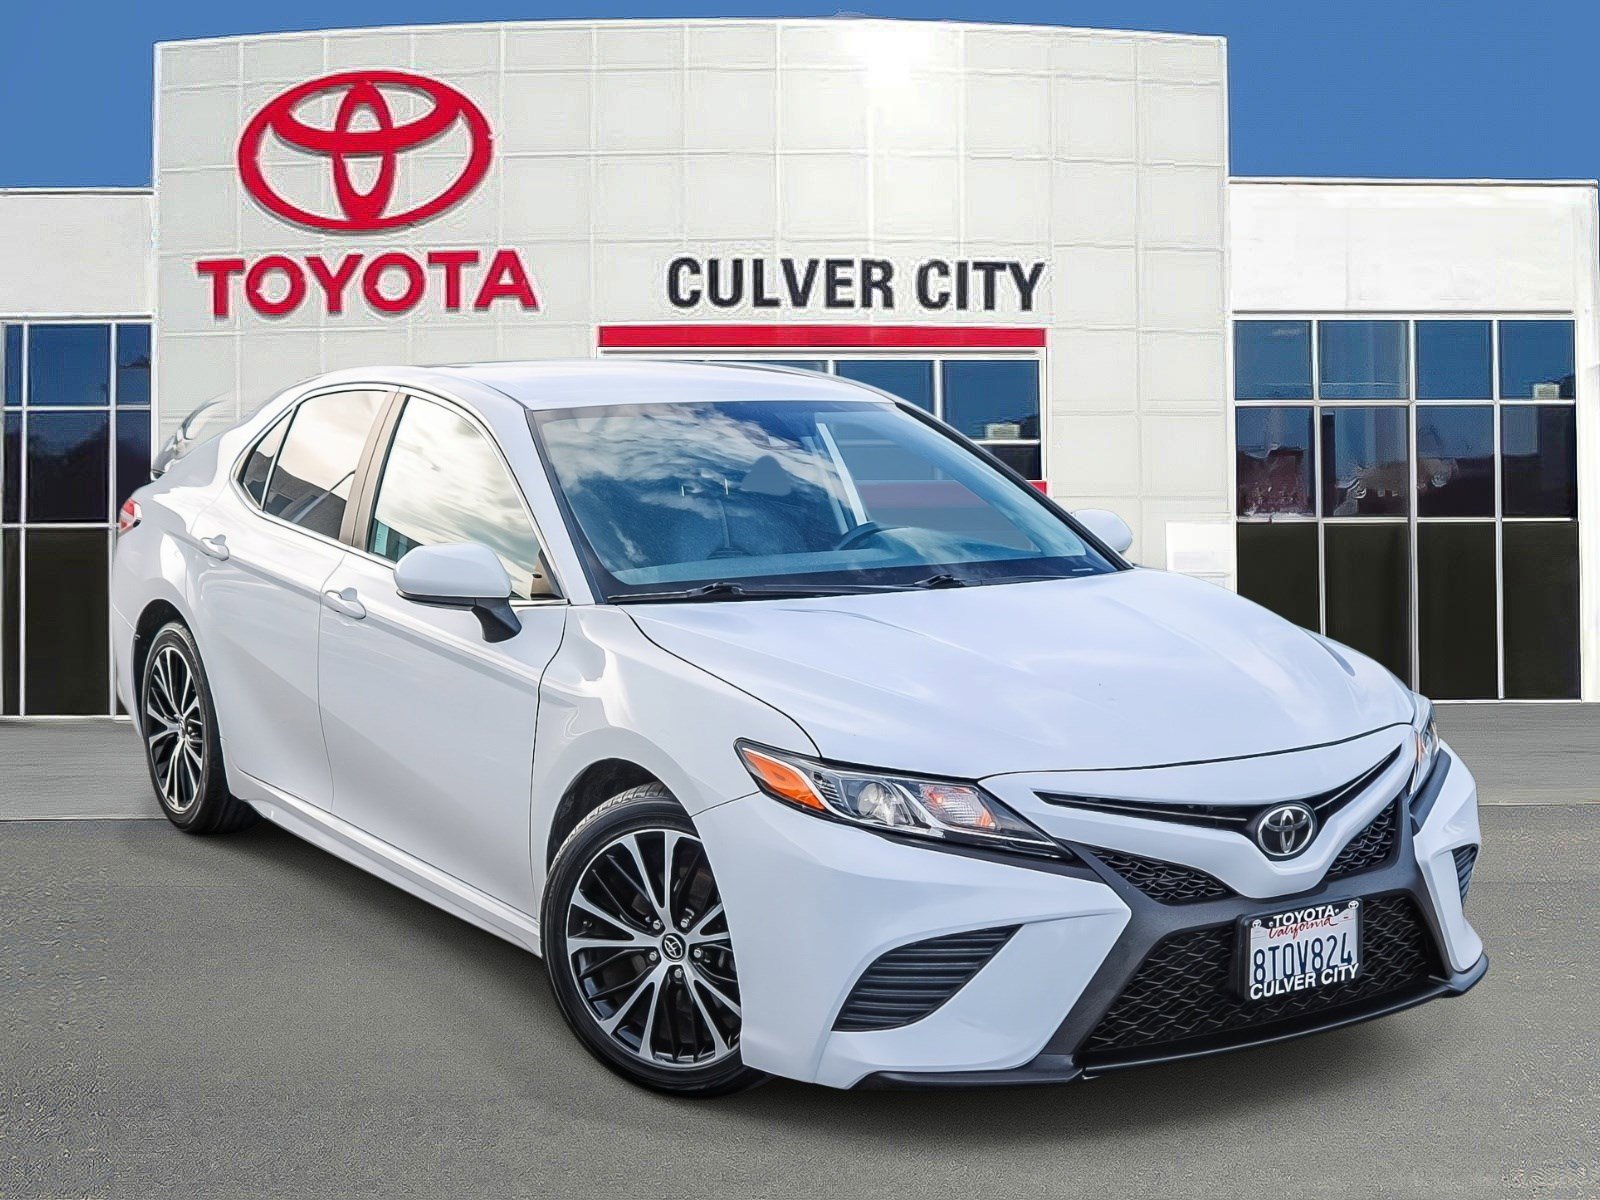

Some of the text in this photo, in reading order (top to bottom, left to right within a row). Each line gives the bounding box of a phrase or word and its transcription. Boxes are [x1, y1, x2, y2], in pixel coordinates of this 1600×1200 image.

[196, 249, 540, 319] TOYOTA
[668, 257, 1045, 312] CULVER CITY
[1268, 917, 1338, 939] California
[1273, 905, 1335, 927] TOYOTA
[1250, 963, 1360, 1000] CULVER CITY
[1254, 932, 1353, 986] 8TOV824
